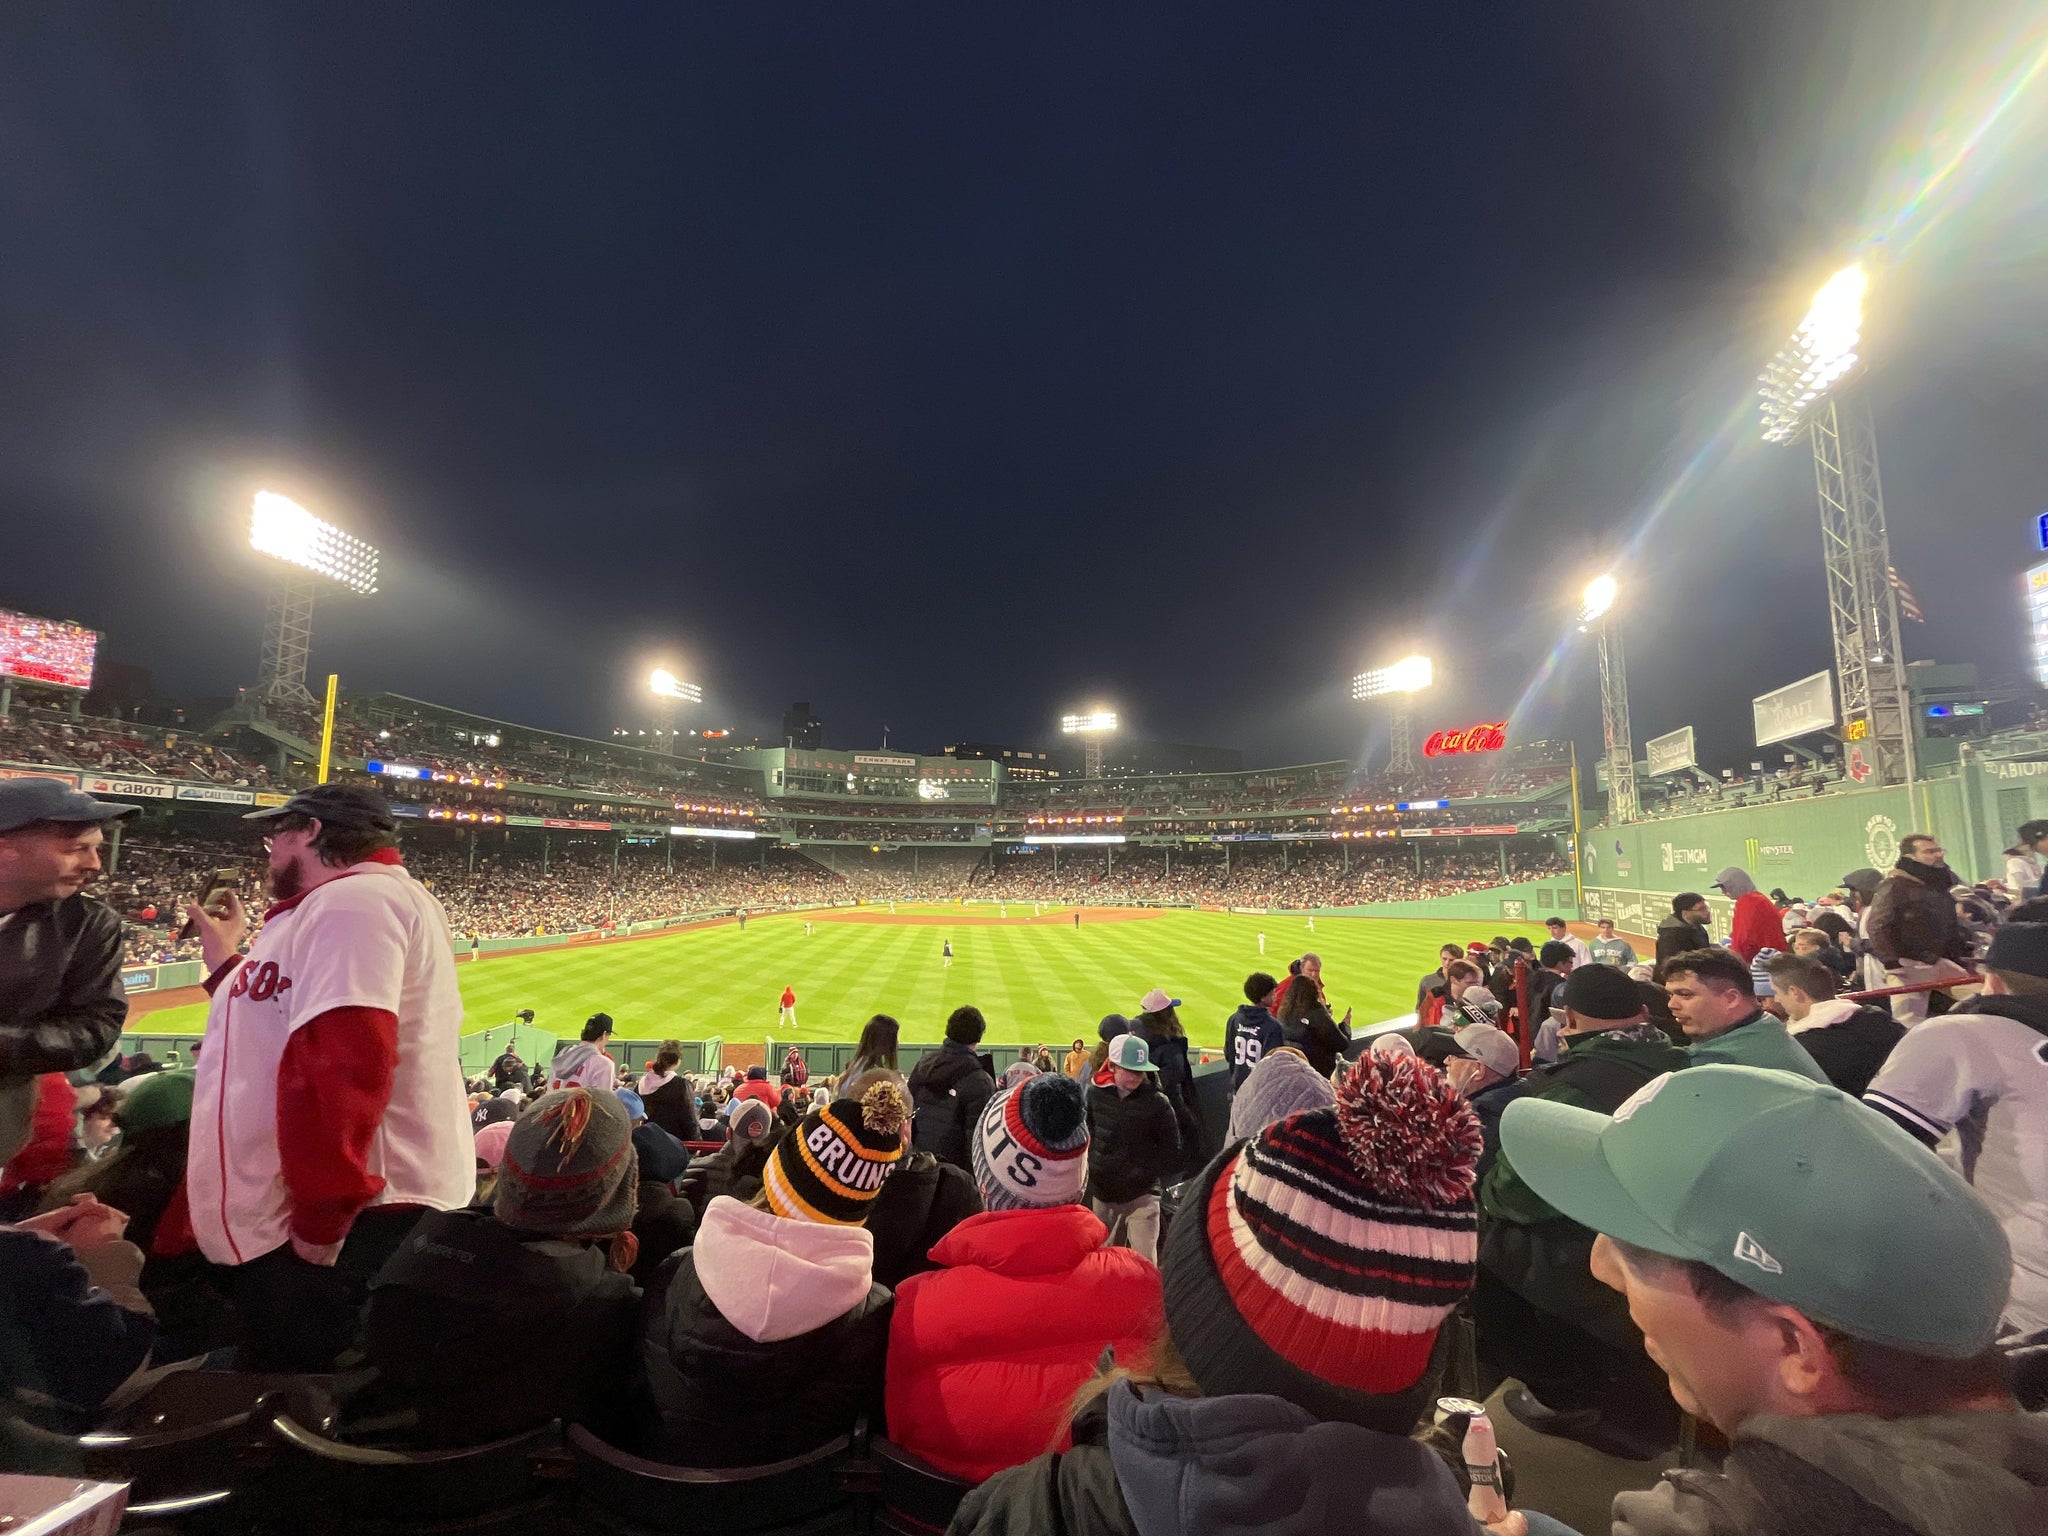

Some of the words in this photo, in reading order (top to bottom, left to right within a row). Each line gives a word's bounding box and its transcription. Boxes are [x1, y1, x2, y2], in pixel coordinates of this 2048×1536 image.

[1424, 722, 1508, 757] Coca-Cola
[1673, 849, 1707, 864] BETMGM
[1760, 844, 1794, 855] MONSTER
[1136, 1049, 1145, 1063] B
[1235, 1035, 1262, 1069] 99
[475, 1107, 489, 1121] NY
